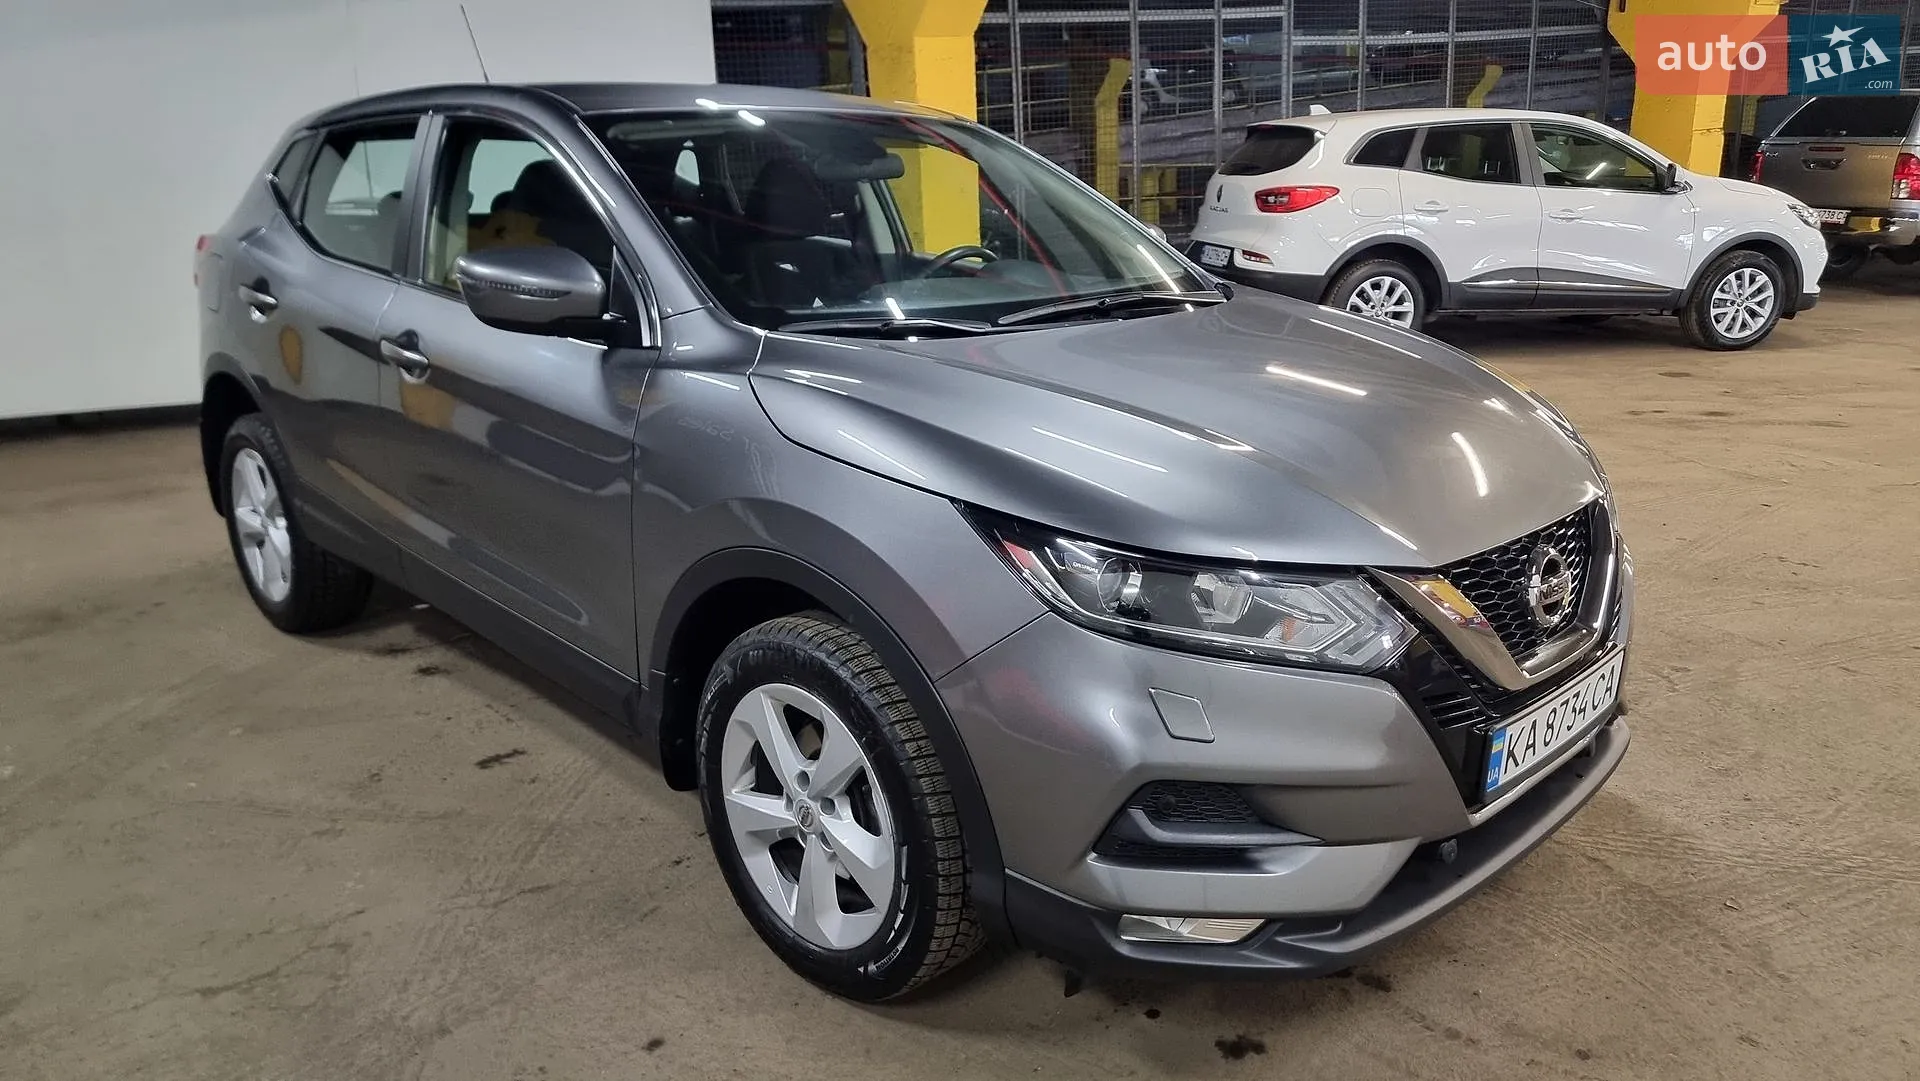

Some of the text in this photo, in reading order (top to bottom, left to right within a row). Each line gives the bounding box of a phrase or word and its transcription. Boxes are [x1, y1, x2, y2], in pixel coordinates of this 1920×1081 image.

[1504, 664, 1616, 775] KA 8734 CA
[1487, 768, 1499, 783] UA
